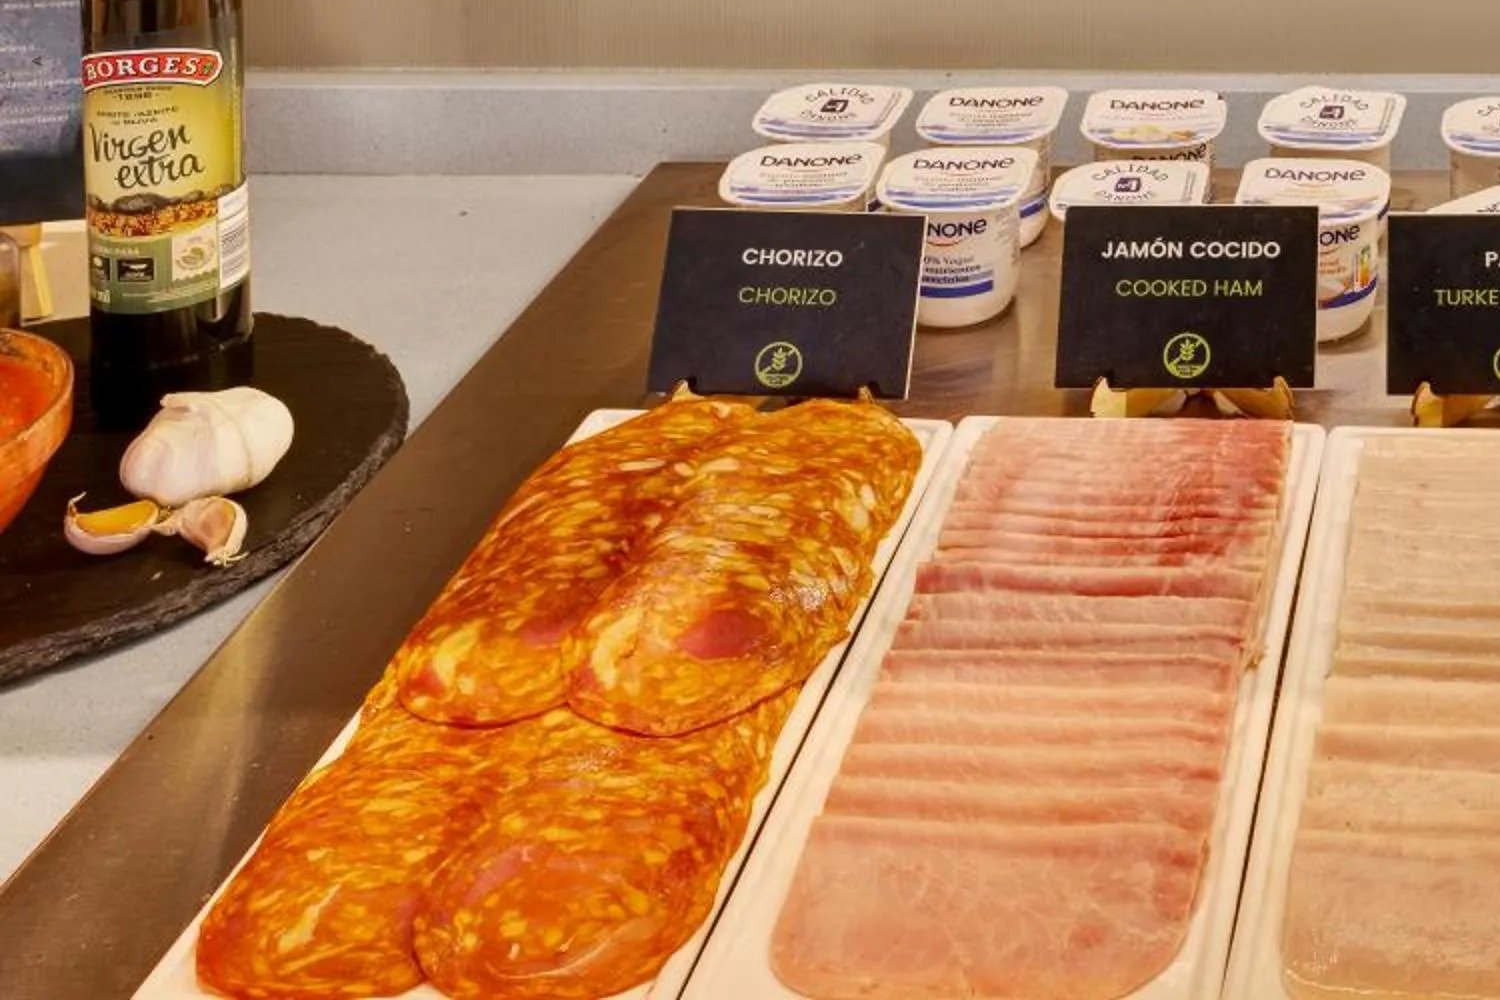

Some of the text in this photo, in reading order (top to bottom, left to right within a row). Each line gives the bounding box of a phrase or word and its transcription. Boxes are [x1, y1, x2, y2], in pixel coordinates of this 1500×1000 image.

[85, 56, 200, 81] BORGES
[114, 153, 206, 189] extra
[927, 218, 988, 239] NONE
[741, 247, 844, 268] CHORIZO
[1101, 236, 1282, 259] JAMÓN COCIDO
[738, 285, 837, 306] CHORIZO
[1115, 279, 1264, 297] COOKED HAM
